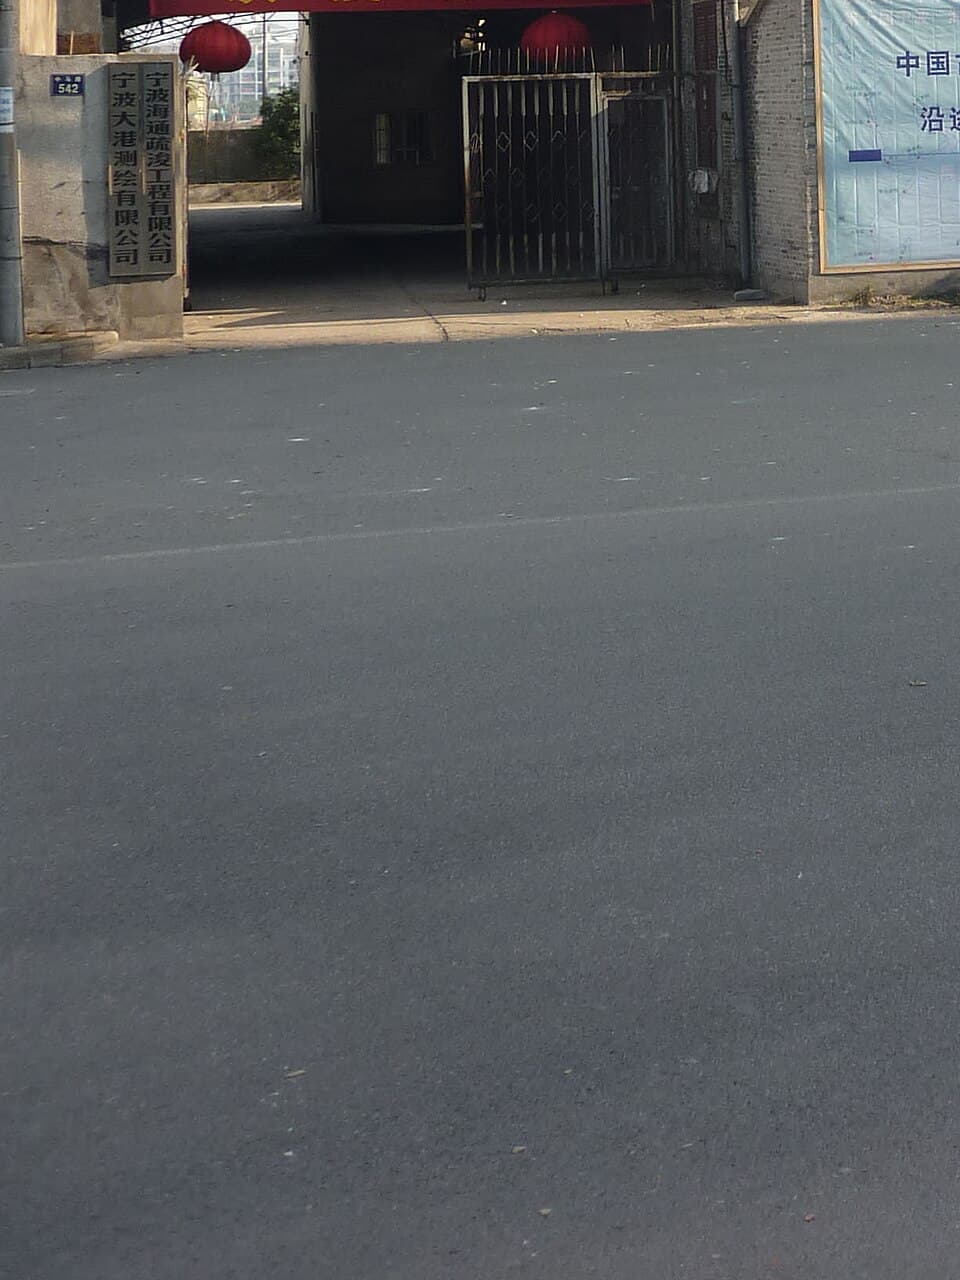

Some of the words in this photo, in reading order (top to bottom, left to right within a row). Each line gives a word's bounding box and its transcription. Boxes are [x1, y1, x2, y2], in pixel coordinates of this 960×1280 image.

[57, 83, 79, 94] 542
[112, 72, 138, 266] 宁波大港测绘有限公司
[146, 72, 172, 265] 宁波海通疏浚工程有限公司
